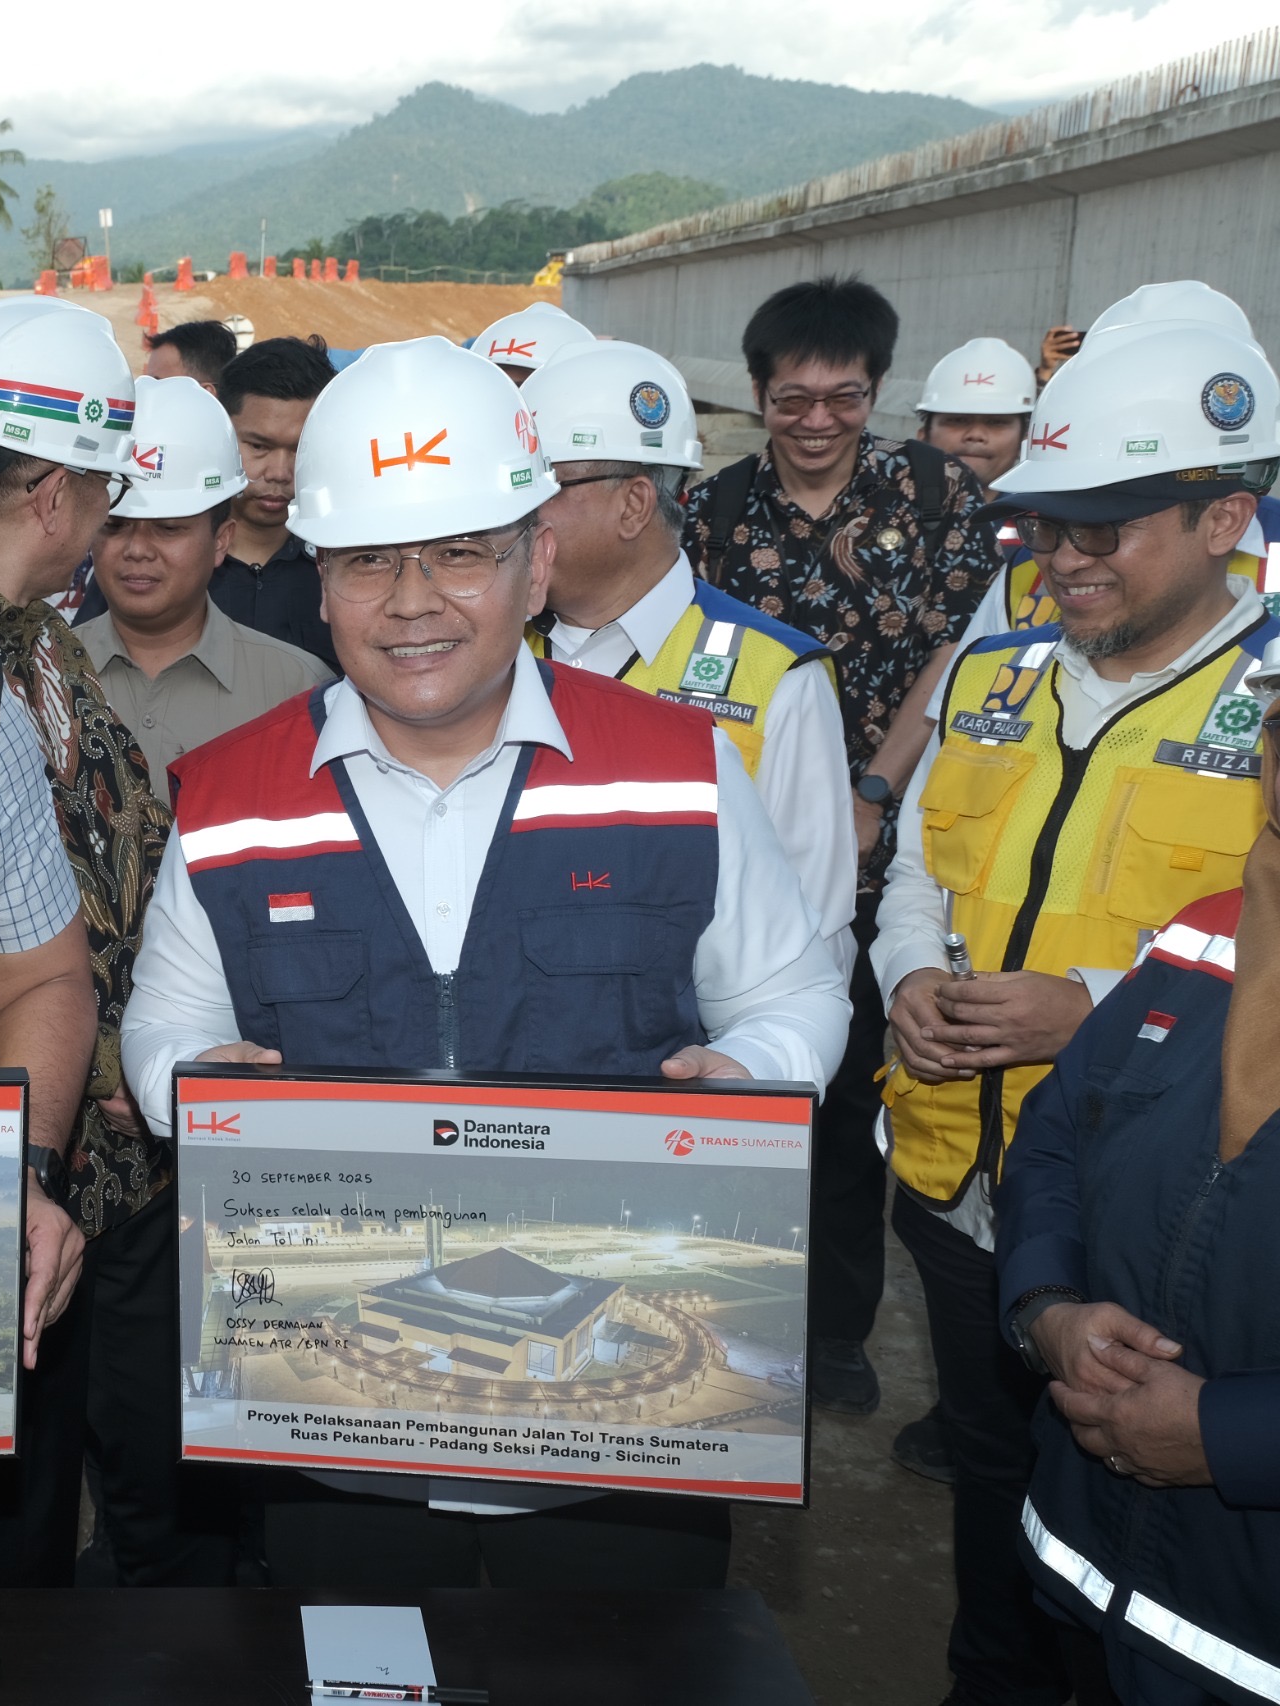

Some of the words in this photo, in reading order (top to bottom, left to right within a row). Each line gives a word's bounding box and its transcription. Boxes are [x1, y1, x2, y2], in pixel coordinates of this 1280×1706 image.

[489, 339, 536, 357] HK
[964, 373, 995, 386] HK
[5, 426, 29, 437] MSA
[574, 434, 596, 444] MSA
[370, 428, 450, 477] HK
[1128, 441, 1157, 451] MSA
[512, 471, 532, 484] MSA
[684, 680, 705, 689] SAFETY
[706, 683, 721, 691] FIRST
[956, 715, 991, 733] KARO
[1201, 732, 1229, 744] SAFETY
[1230, 736, 1254, 748] FIRST
[1181, 749, 1251, 771] REIZA
[571, 871, 611, 891] HK
[188, 1111, 240, 1134] HK
[464, 1119, 550, 1136] Danantara
[464, 1134, 545, 1150] Indonesia
[700, 1137, 739, 1146] TRANS
[741, 1139, 803, 1149] SUMATERA
[232, 1170, 251, 1184] 30
[261, 1172, 331, 1184] SEPTEMBER
[339, 1173, 373, 1184] 2025
[223, 1199, 280, 1217] Sukses
[292, 1203, 331, 1216] selalu
[340, 1204, 386, 1220] dalam
[395, 1205, 486, 1228] pembangunan
[227, 1231, 260, 1247] Jalan
[273, 1233, 292, 1246] Tol
[226, 1318, 256, 1329] OSSY
[264, 1319, 323, 1329] DERMAWAN
[214, 1336, 264, 1347] WAMEN
[335, 1339, 348, 1349] RI
[247, 1410, 299, 1424] Proyek
[304, 1413, 401, 1430] Pelaksanaan
[406, 1420, 517, 1437] Pembangunan
[523, 1427, 565, 1441] Jalan
[570, 1430, 593, 1443] Tol
[598, 1432, 644, 1446] Trans
[650, 1436, 729, 1452] Sumatera
[290, 1428, 328, 1441] Ruas
[333, 1431, 414, 1447] Pekanbaru
[429, 1437, 488, 1454] Padang
[493, 1441, 535, 1455] Seksi
[541, 1445, 600, 1462] Padang
[616, 1450, 681, 1465] Sicincin
